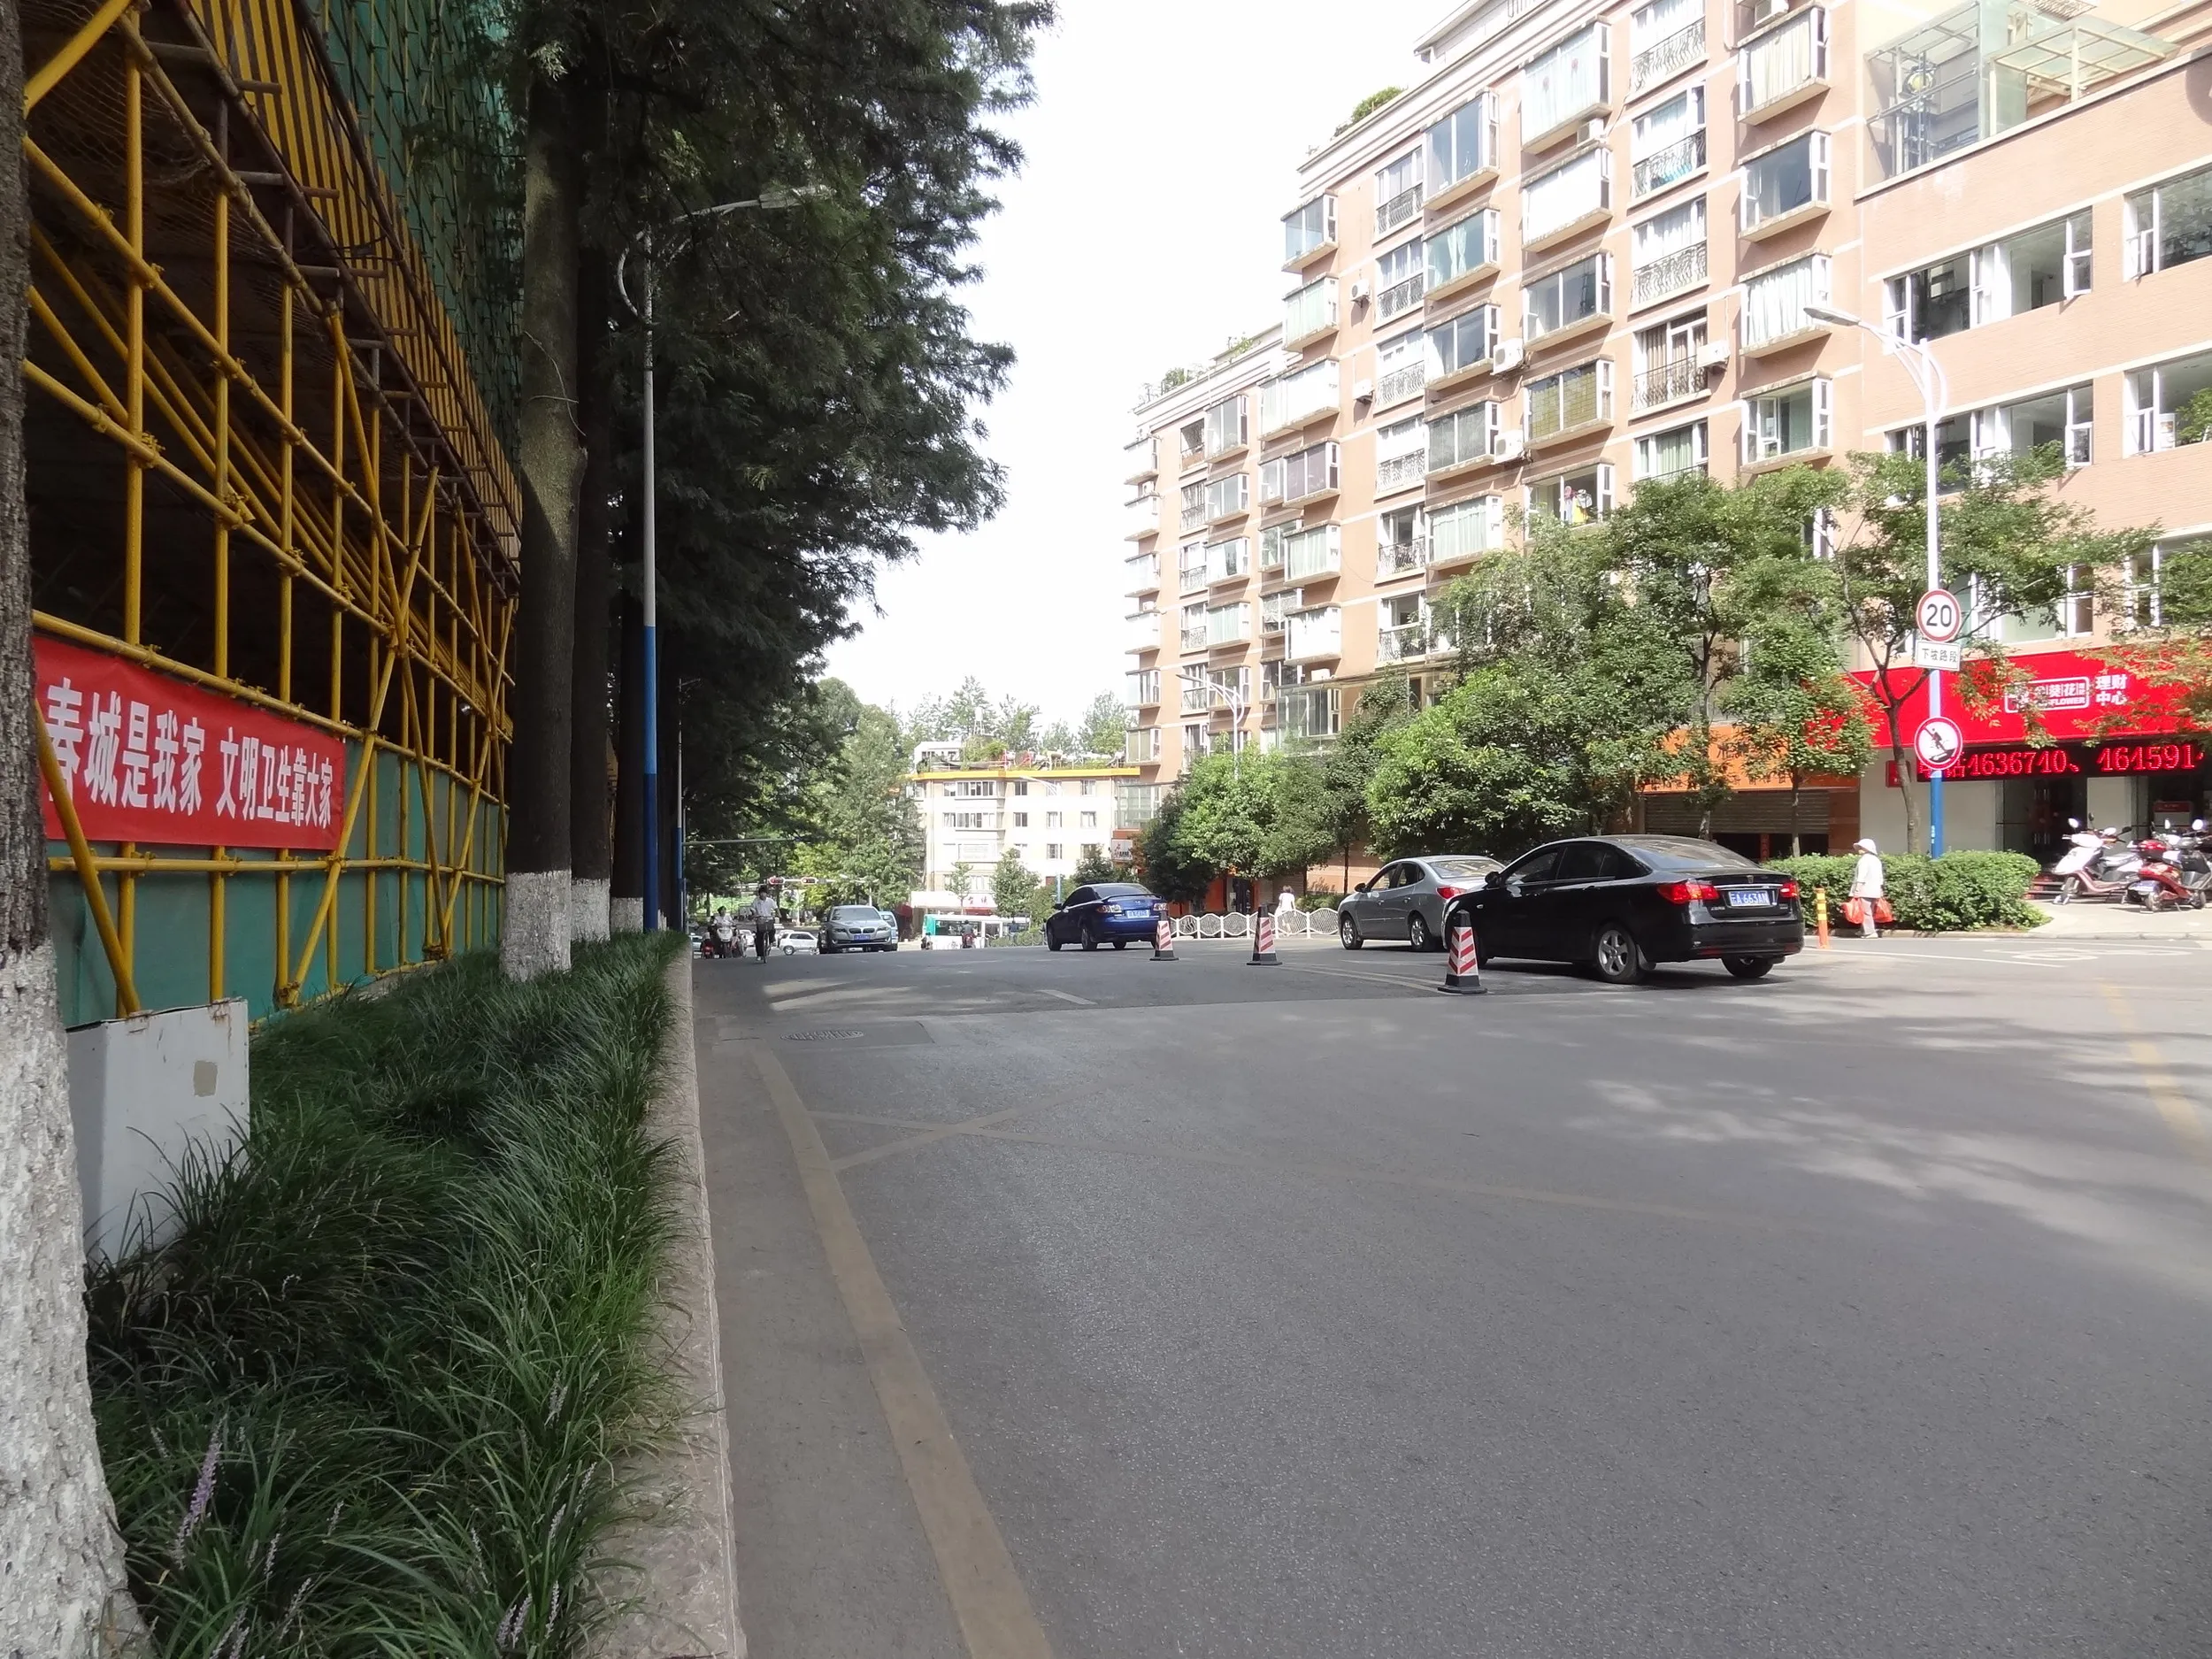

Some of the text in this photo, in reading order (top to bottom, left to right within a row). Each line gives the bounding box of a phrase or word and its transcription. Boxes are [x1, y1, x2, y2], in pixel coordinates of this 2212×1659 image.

[1926, 603, 1952, 627] 20
[1922, 648, 1957, 663] 下坡路段
[2095, 674, 2128, 690] 理财
[2095, 691, 2128, 706] 中心
[215, 726, 334, 829] 文明卫生靠大家
